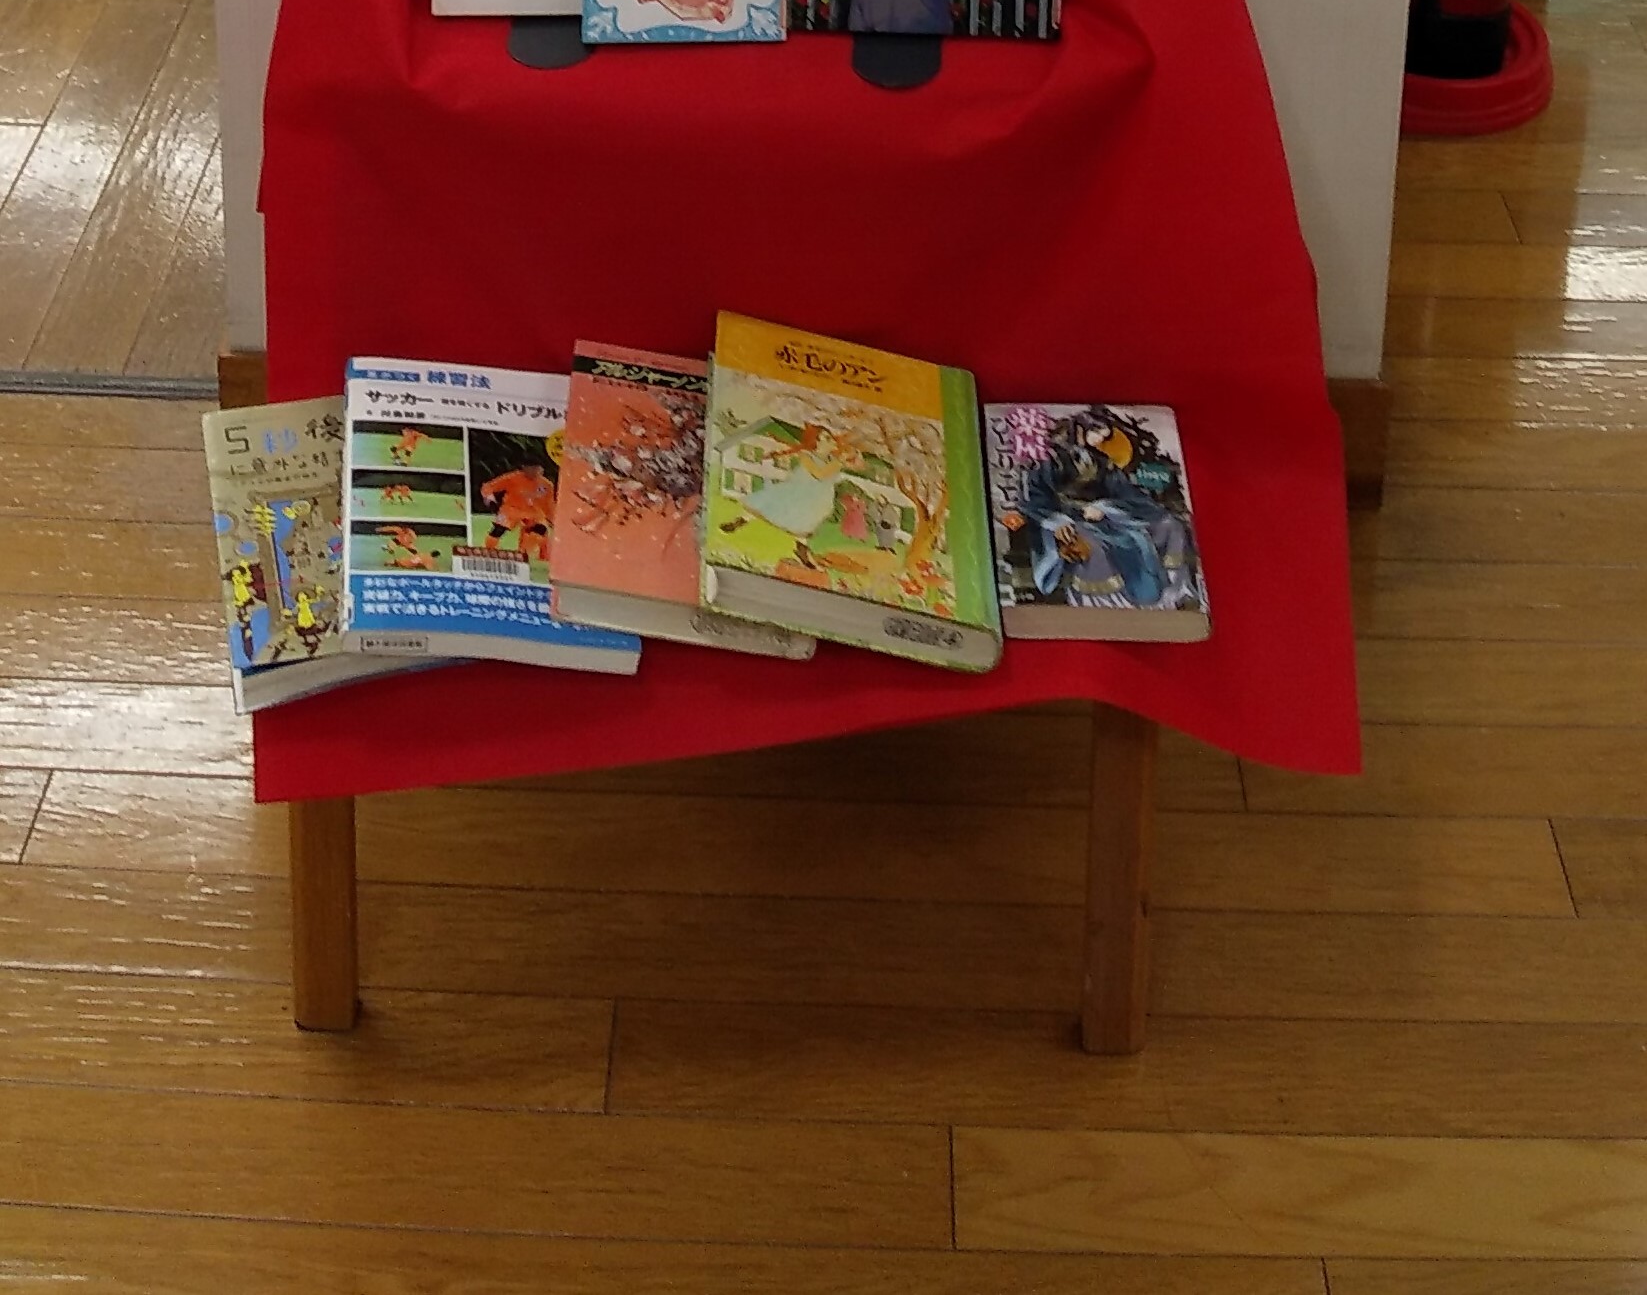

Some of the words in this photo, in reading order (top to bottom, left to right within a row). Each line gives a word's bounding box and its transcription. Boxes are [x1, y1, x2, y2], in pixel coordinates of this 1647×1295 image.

[591, 357, 708, 393] アルジャーノン
[775, 341, 887, 385] 赤毛のアン
[365, 389, 434, 405] サッカー
[496, 400, 567, 420] ドリブル
[230, 450, 344, 476] に意外な結
